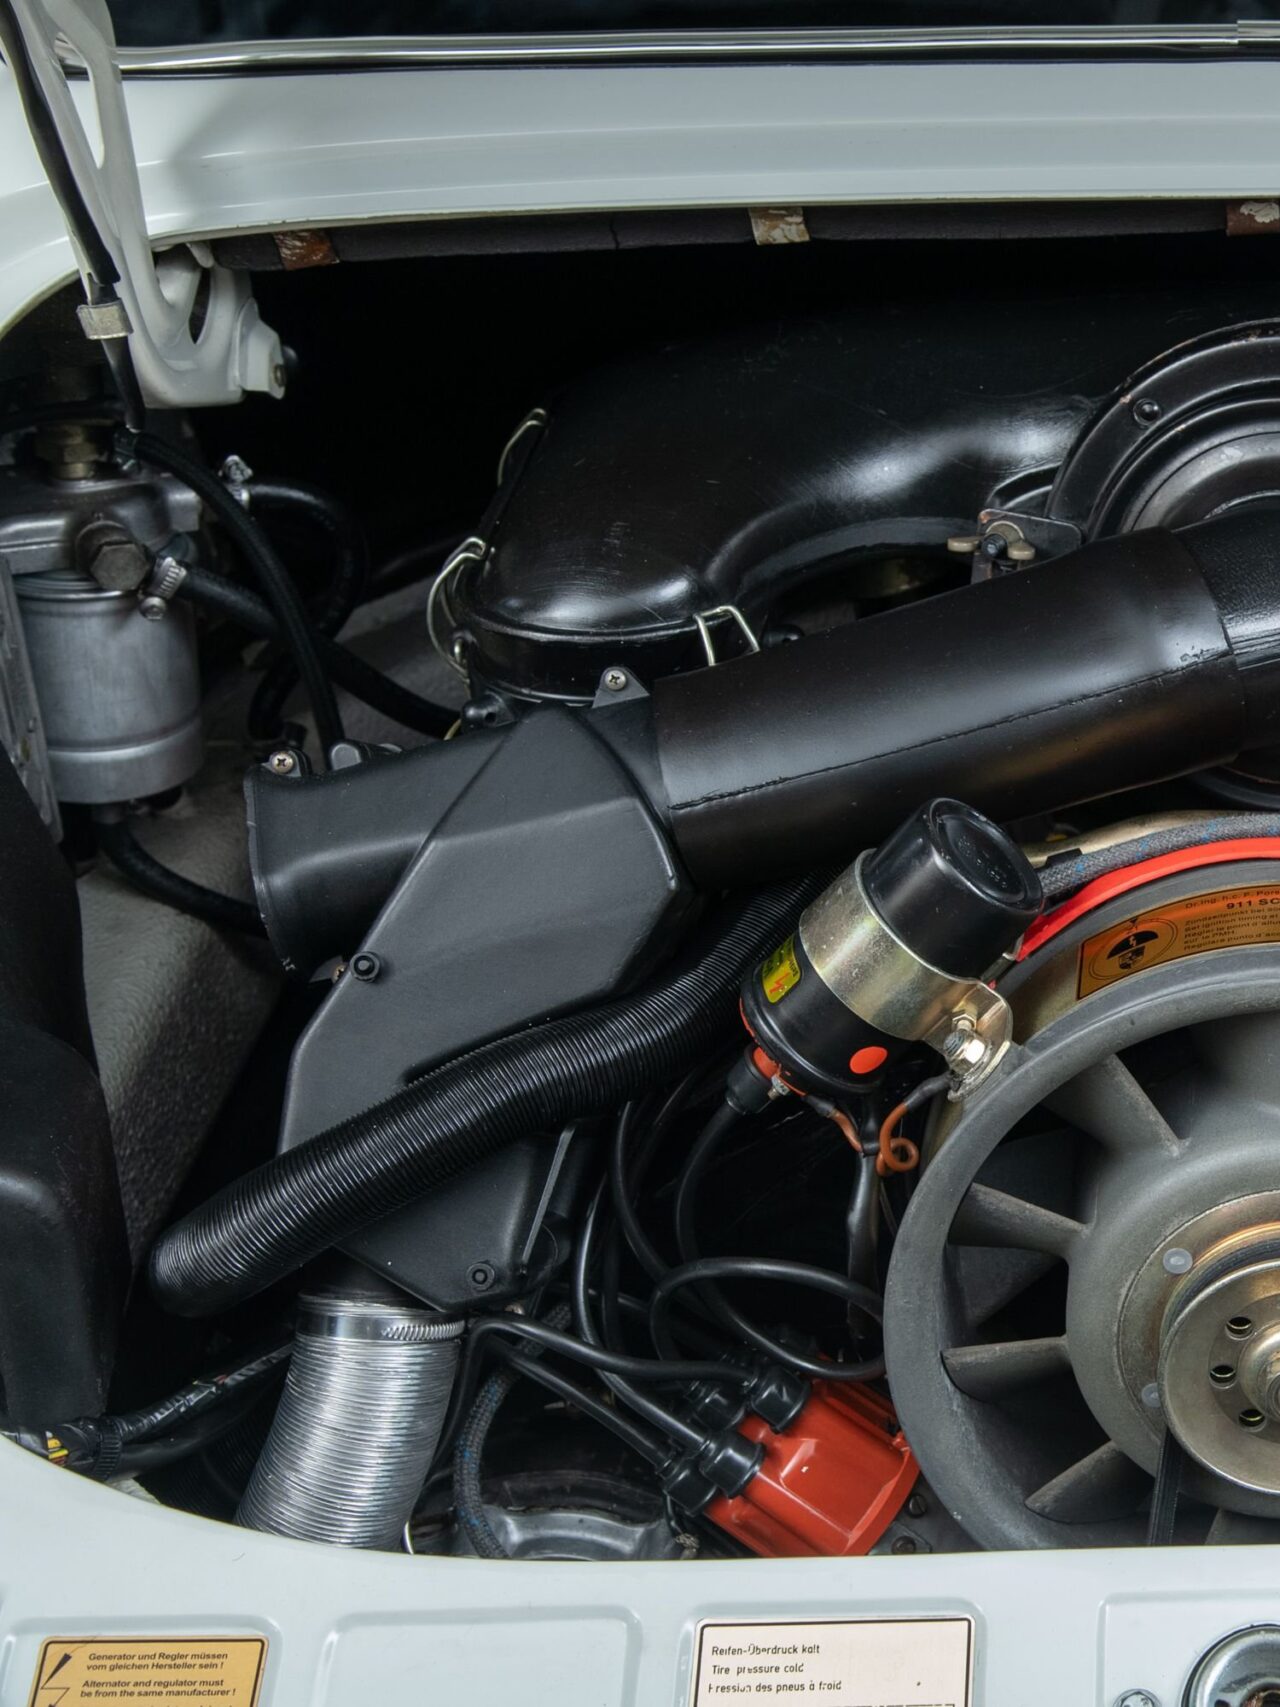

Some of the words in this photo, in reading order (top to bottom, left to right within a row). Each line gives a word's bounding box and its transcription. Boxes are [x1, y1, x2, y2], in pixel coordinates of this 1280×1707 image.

[1226, 899, 1253, 910] 911
[1258, 897, 1280, 906] SC
[88, 1652, 137, 1663] Generator
[137, 1652, 157, 1663] und
[158, 1652, 189, 1664] Regler
[190, 1651, 228, 1662] müssen
[86, 1664, 108, 1672] vom
[109, 1662, 150, 1674] gleichen
[151, 1661, 197, 1672] Hersteller
[198, 1661, 219, 1671] sein
[712, 1664, 731, 1675] Tire
[82, 1679, 131, 1690] Alternator
[132, 1679, 153, 1689] and
[153, 1678, 197, 1690] regulator
[199, 1678, 224, 1688] must
[755, 1682, 773, 1693] des
[776, 1683, 806, 1694] pneus
[808, 1680, 816, 1692] à
[80, 1689, 93, 1699] be
[94, 1689, 118, 1699] from
[118, 1688, 136, 1698] the
[137, 1689, 164, 1698] same
[165, 1687, 229, 1698] manufacturer
